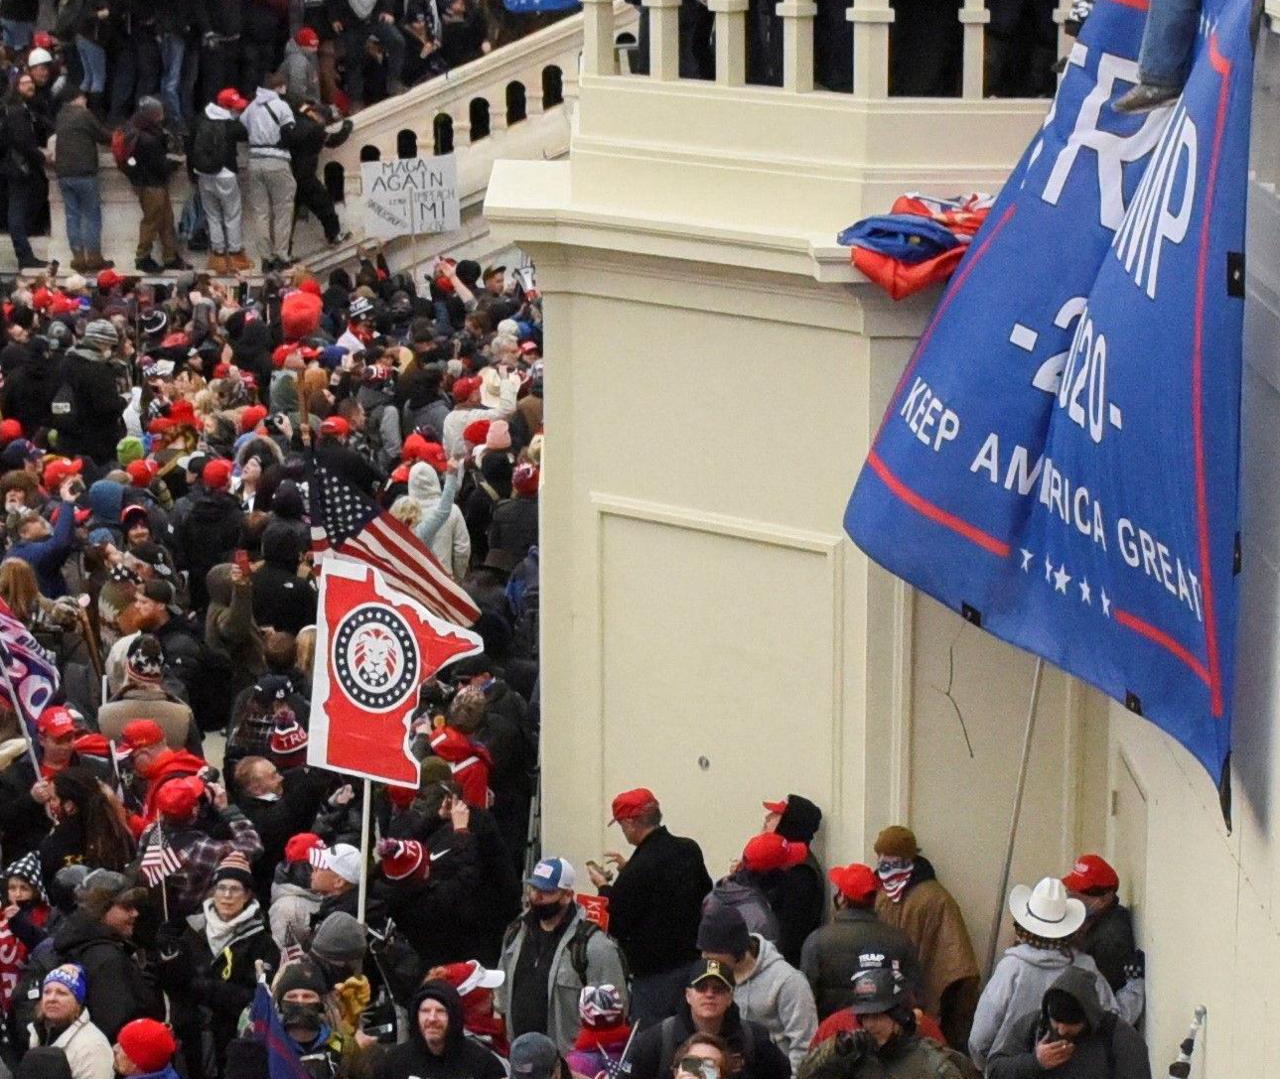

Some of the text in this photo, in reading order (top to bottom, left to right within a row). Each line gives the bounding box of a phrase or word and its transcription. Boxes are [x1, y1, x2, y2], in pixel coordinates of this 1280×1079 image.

[381, 159, 428, 175] MAGA
[371, 170, 444, 193] AGAIN
[420, 200, 446, 220] MI
[899, 376, 960, 452] KEEP
